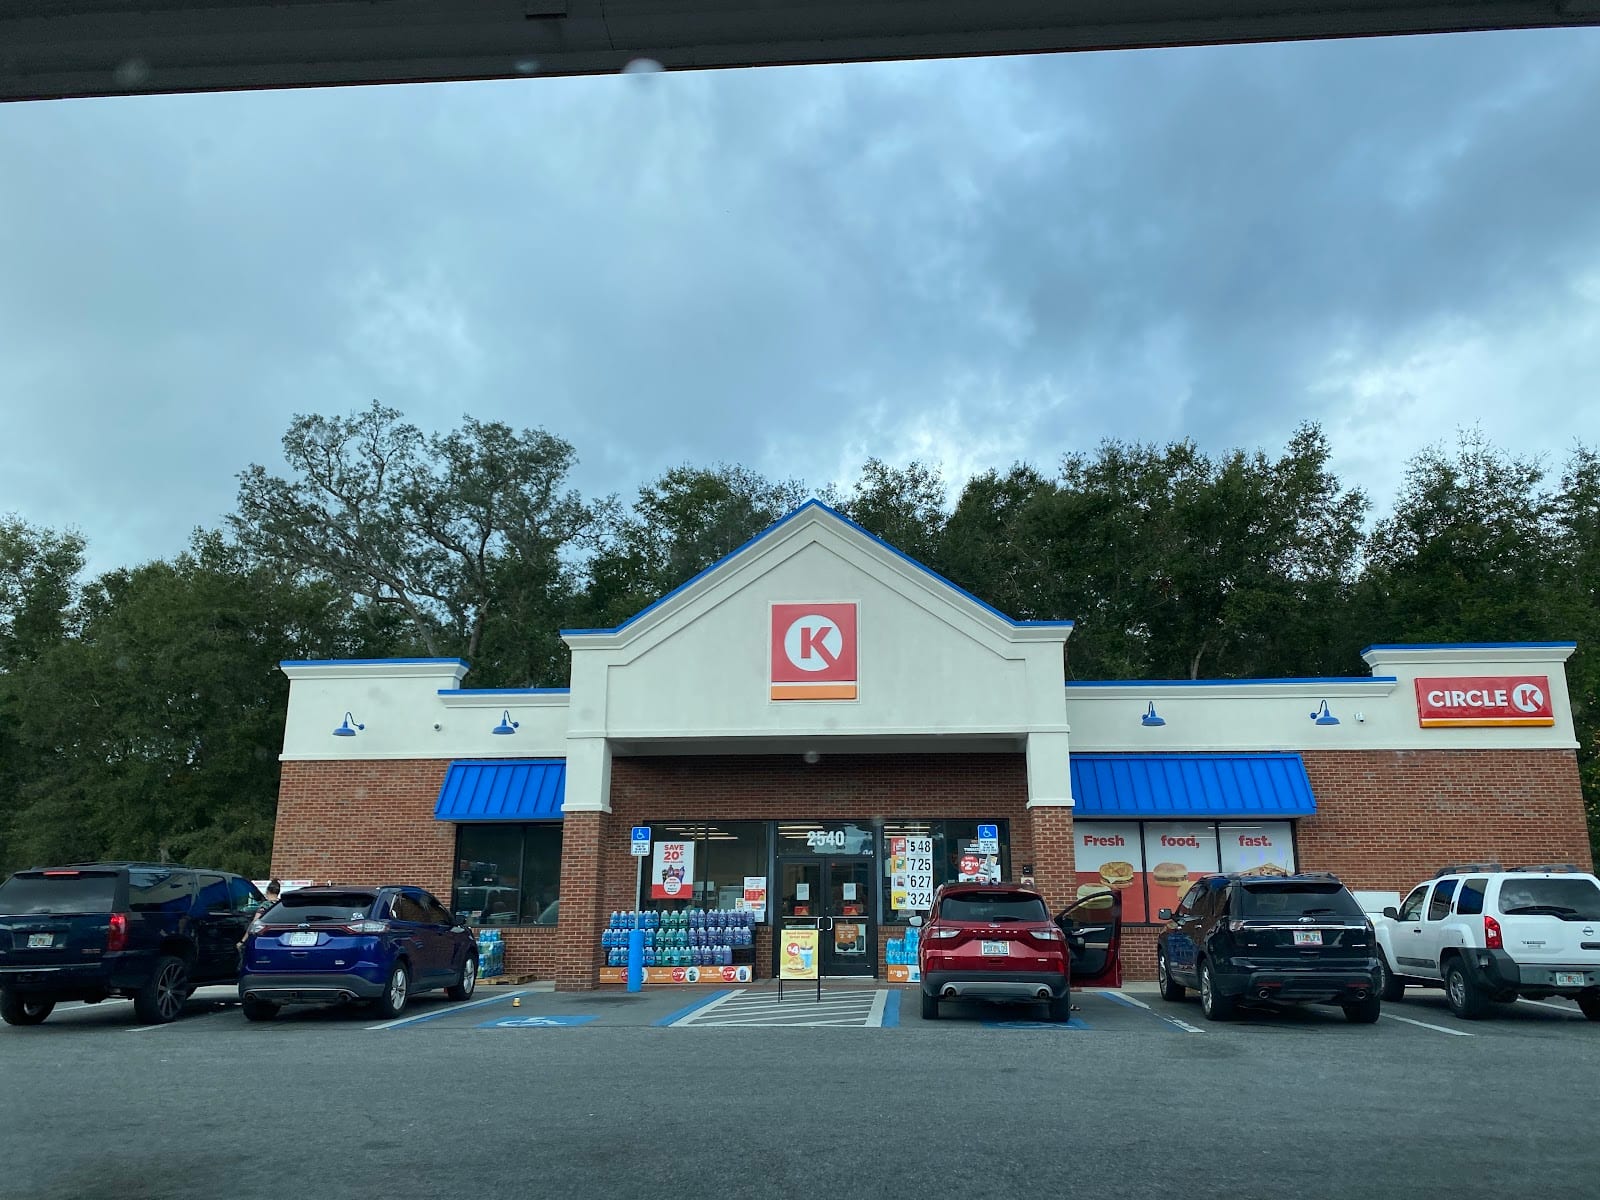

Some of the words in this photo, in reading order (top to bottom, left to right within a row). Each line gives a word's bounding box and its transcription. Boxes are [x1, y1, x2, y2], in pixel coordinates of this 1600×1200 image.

[1427, 689, 1509, 708] CIRCLE
[806, 830, 845, 846] 2540
[1083, 834, 1125, 847] Fresh
[1160, 834, 1200, 848] food,
[1238, 834, 1273, 847] fast.
